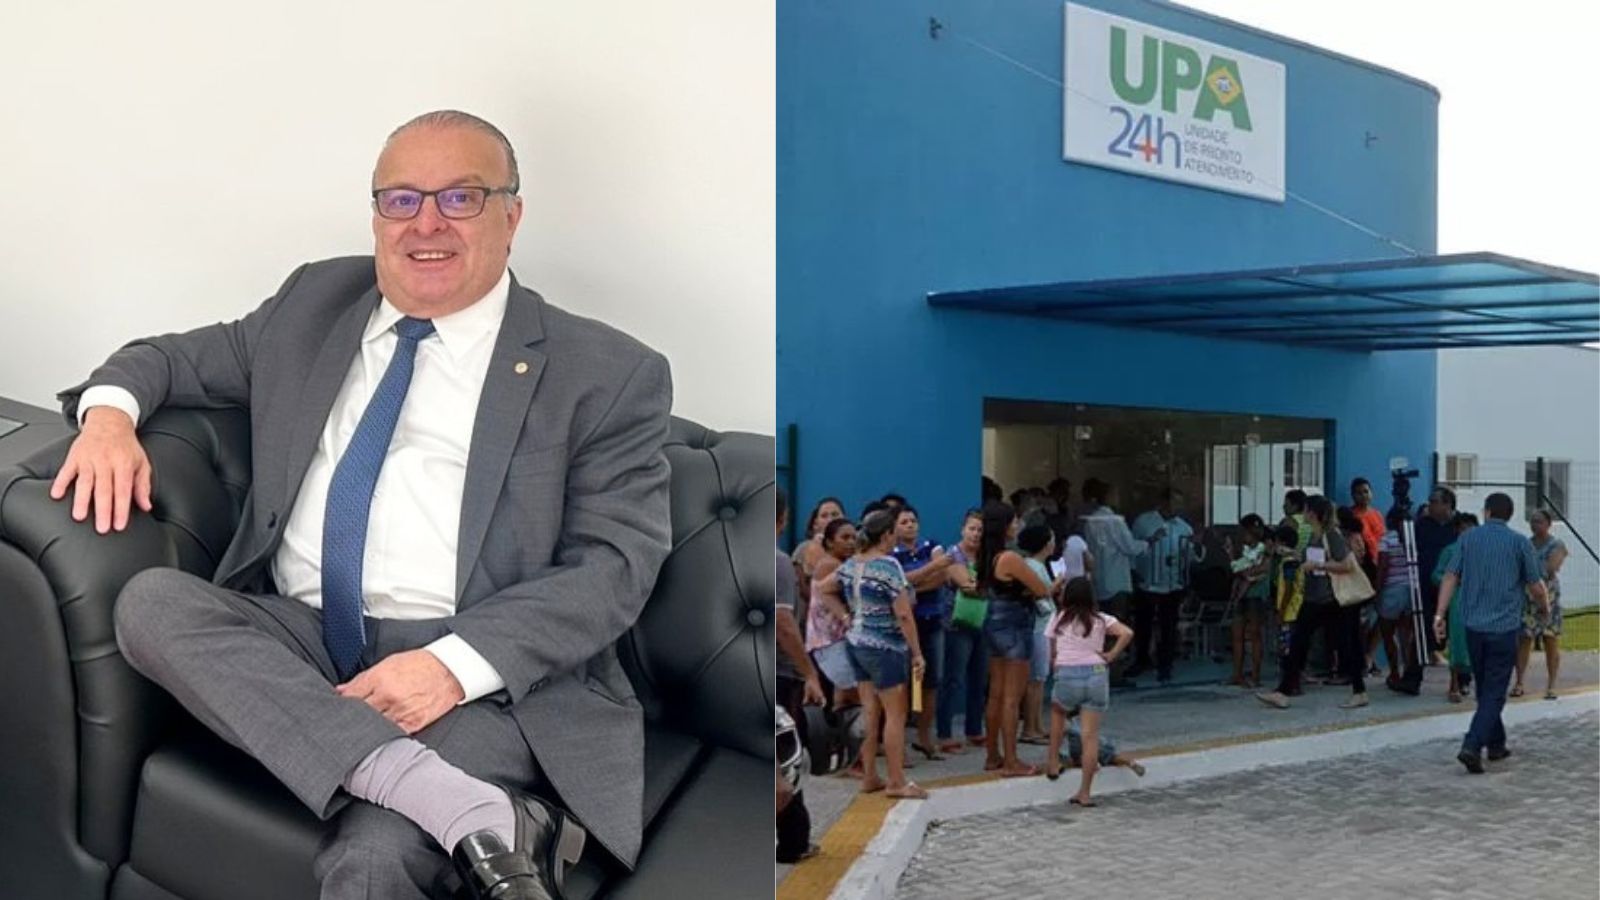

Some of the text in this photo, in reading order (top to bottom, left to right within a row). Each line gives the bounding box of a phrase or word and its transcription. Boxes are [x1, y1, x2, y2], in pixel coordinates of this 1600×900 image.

[1109, 25, 1252, 132] UPA
[1108, 105, 1181, 169] 24h
[1184, 124, 1229, 146] UNIDADE
[1184, 140, 1243, 165] DE PRONTO
[1184, 158, 1254, 184] ATENDIMENTO
